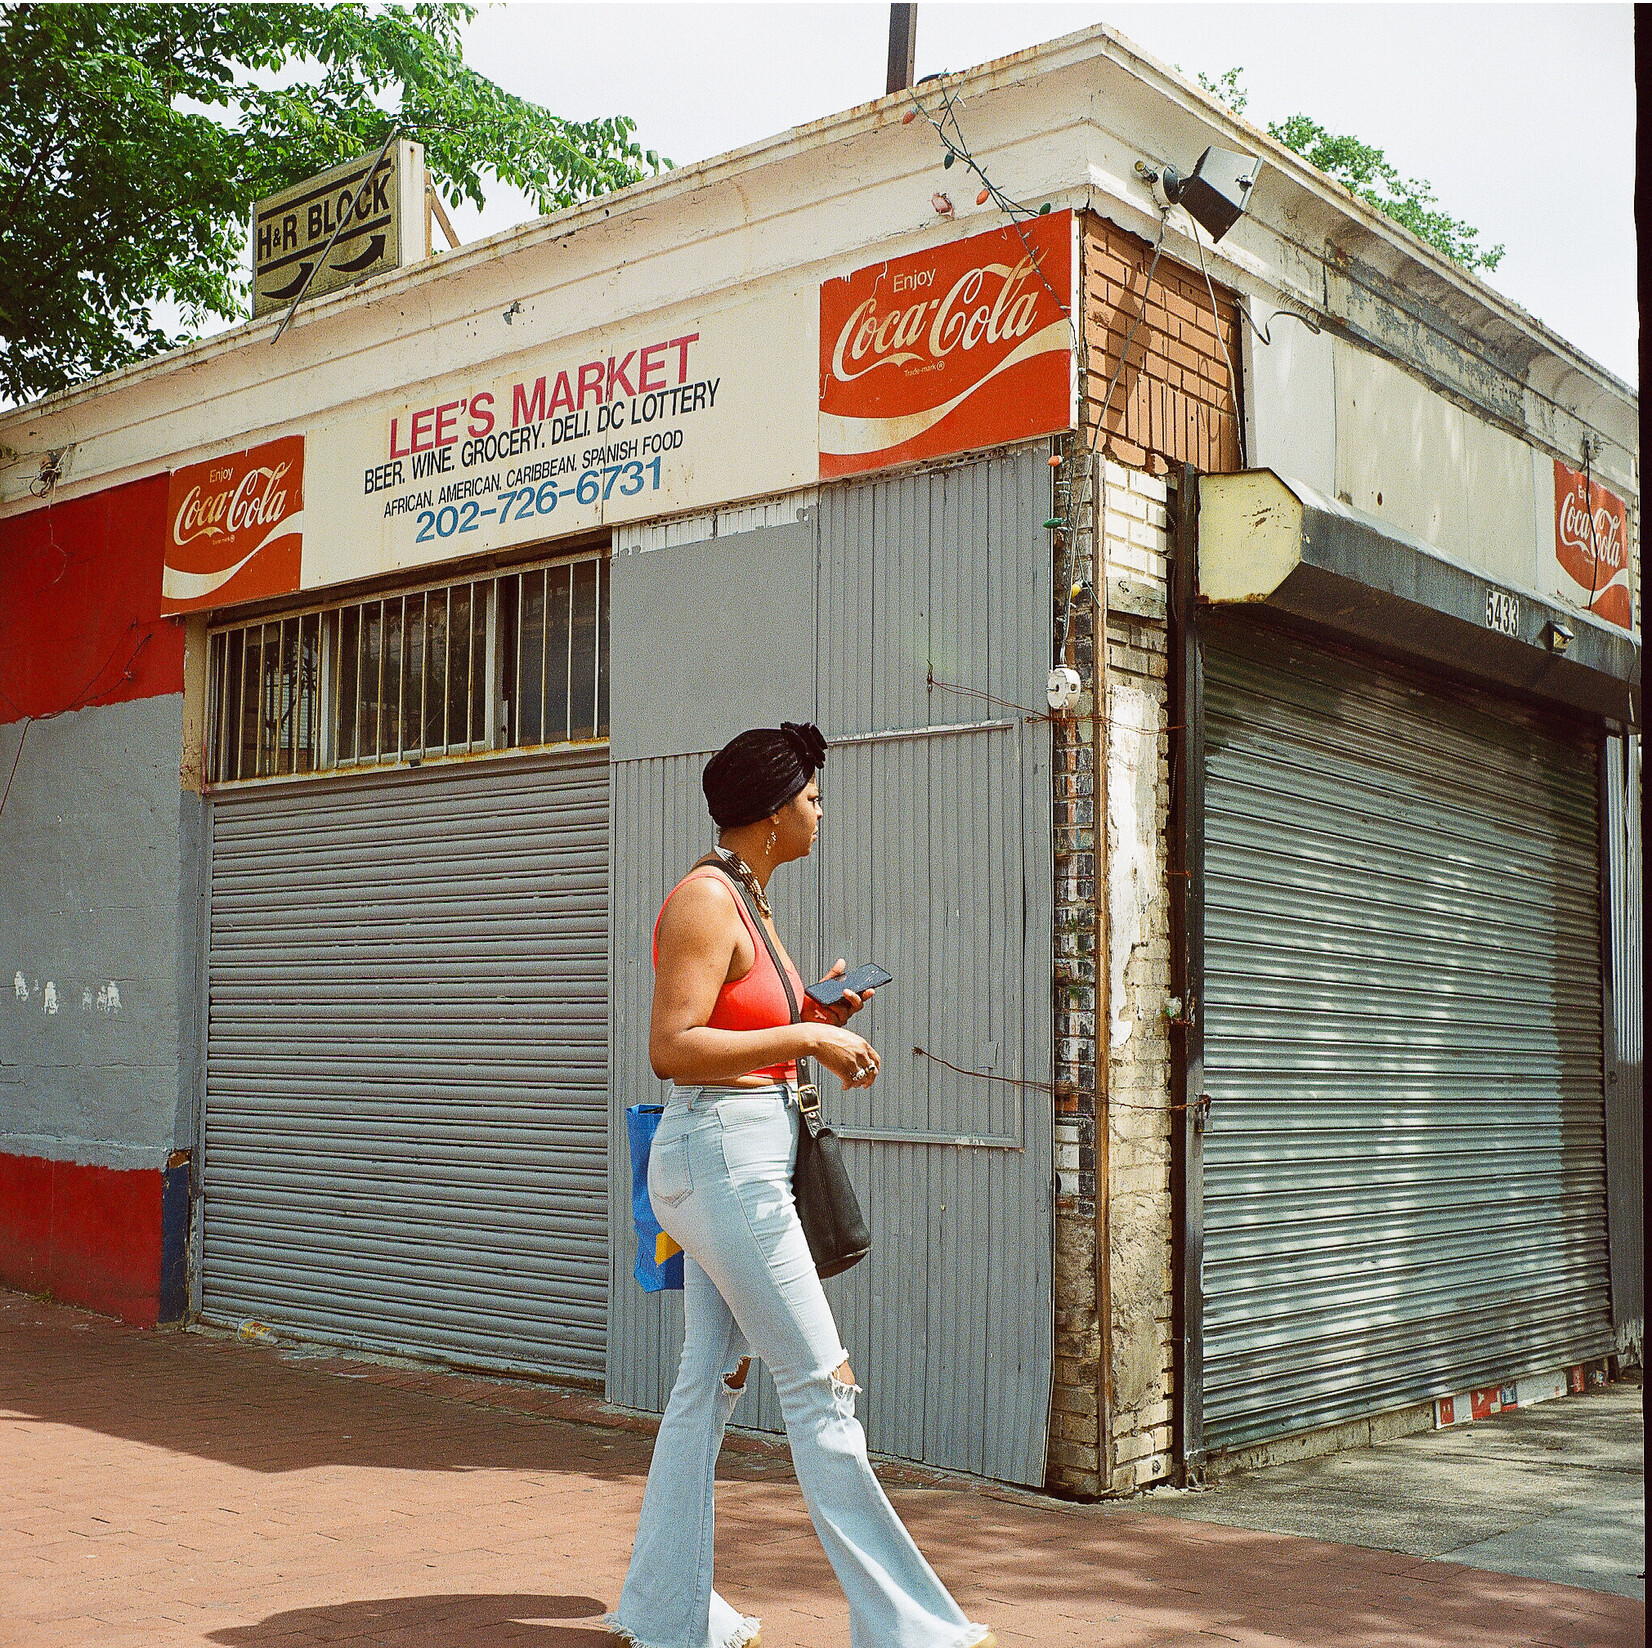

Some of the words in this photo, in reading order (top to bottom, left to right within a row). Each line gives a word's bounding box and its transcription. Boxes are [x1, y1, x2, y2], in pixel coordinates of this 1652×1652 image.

[257, 213, 298, 262] H&R
[307, 172, 391, 241] BLOCK
[832, 247, 1050, 382] Coca-Cola
[892, 267, 937, 293] Enjoy
[364, 460, 406, 495] BEER.
[411, 446, 455, 480] WINE.
[461, 423, 546, 468] GROCERY.
[551, 410, 591, 446] DELI.
[597, 401, 625, 433] DC
[630, 377, 721, 425] LOTTERY
[389, 392, 495, 460] LEE'S
[512, 332, 700, 429] MARKET
[173, 459, 294, 546] Coca-Cola
[209, 467, 234, 483] Enjoy
[383, 489, 434, 519] AFRICAN.
[437, 473, 502, 505] AMERICAN.
[506, 454, 577, 488] CARIBBEAN.
[581, 438, 638, 469] SPANISH
[642, 429, 684, 455] FOOD
[415, 456, 662, 544] 202-726-6731
[1486, 588, 1519, 637] 5433
